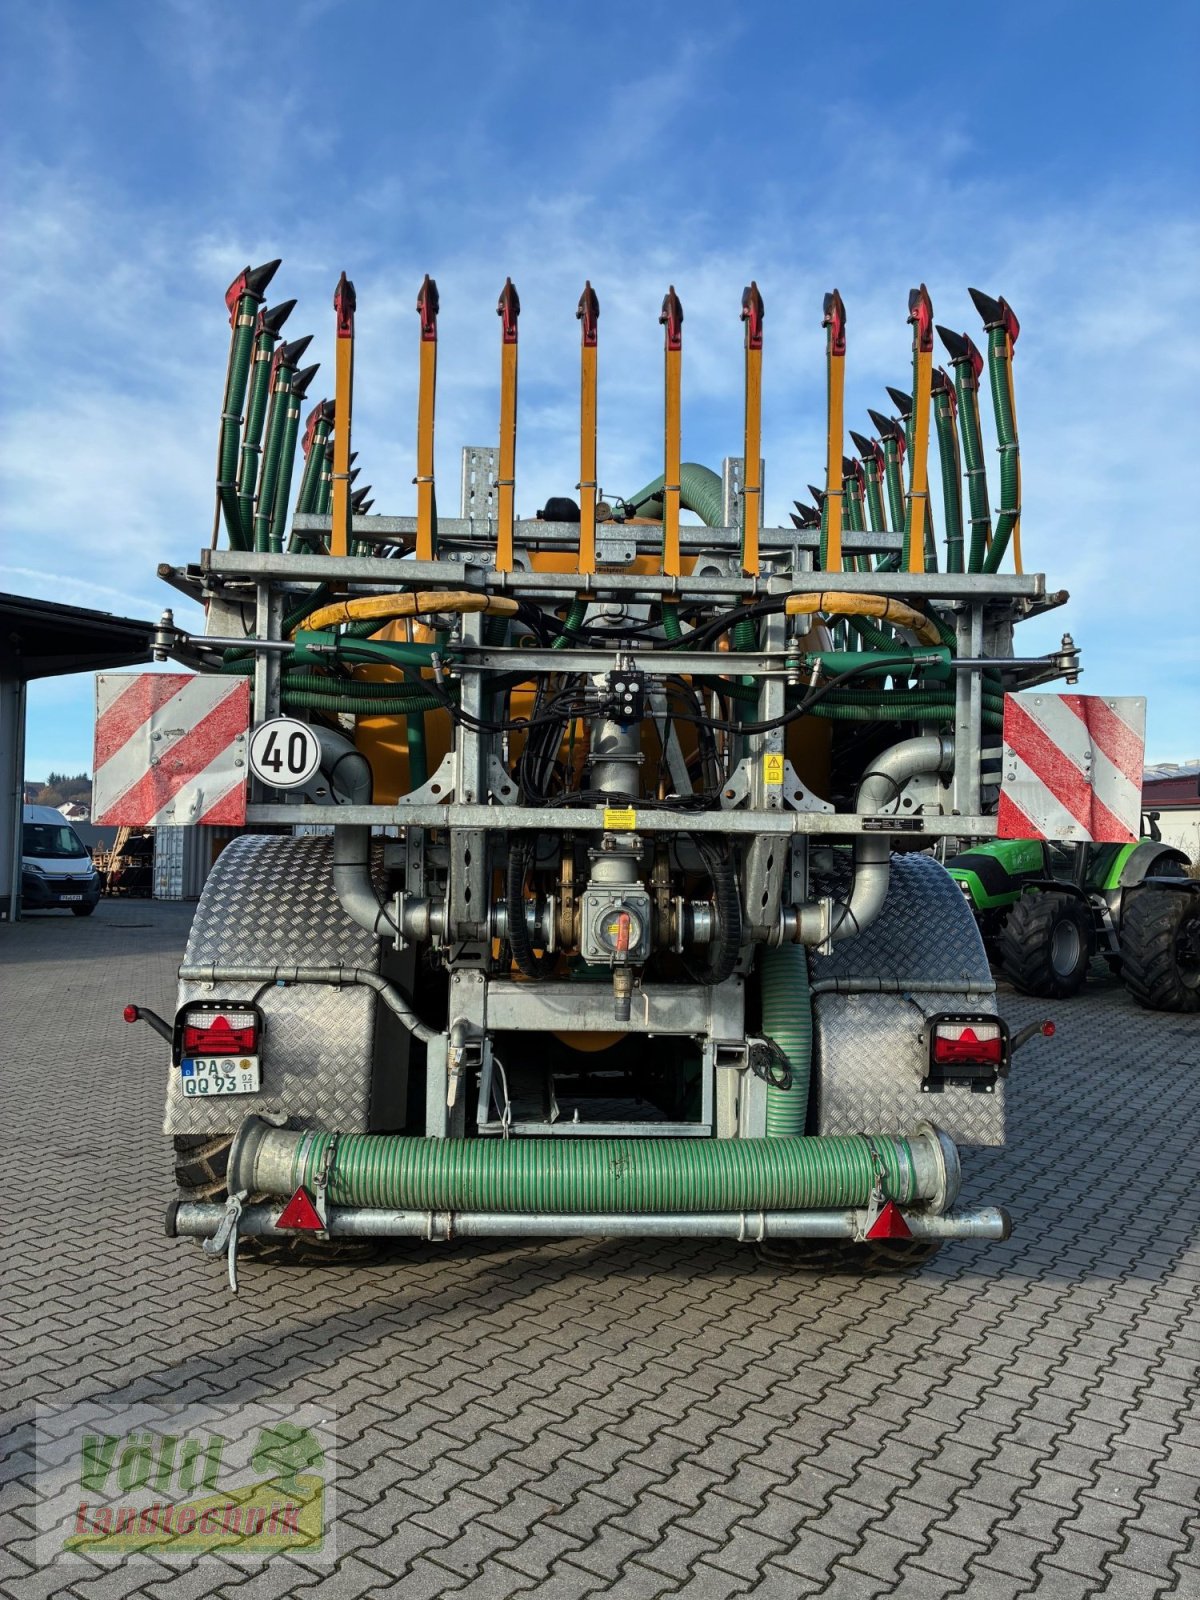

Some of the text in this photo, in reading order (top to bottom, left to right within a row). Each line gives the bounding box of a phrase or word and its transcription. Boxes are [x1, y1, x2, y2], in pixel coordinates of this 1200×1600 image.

[261, 731, 307, 774] 40
[195, 1060, 219, 1076] PA
[215, 1076, 237, 1092] 93
